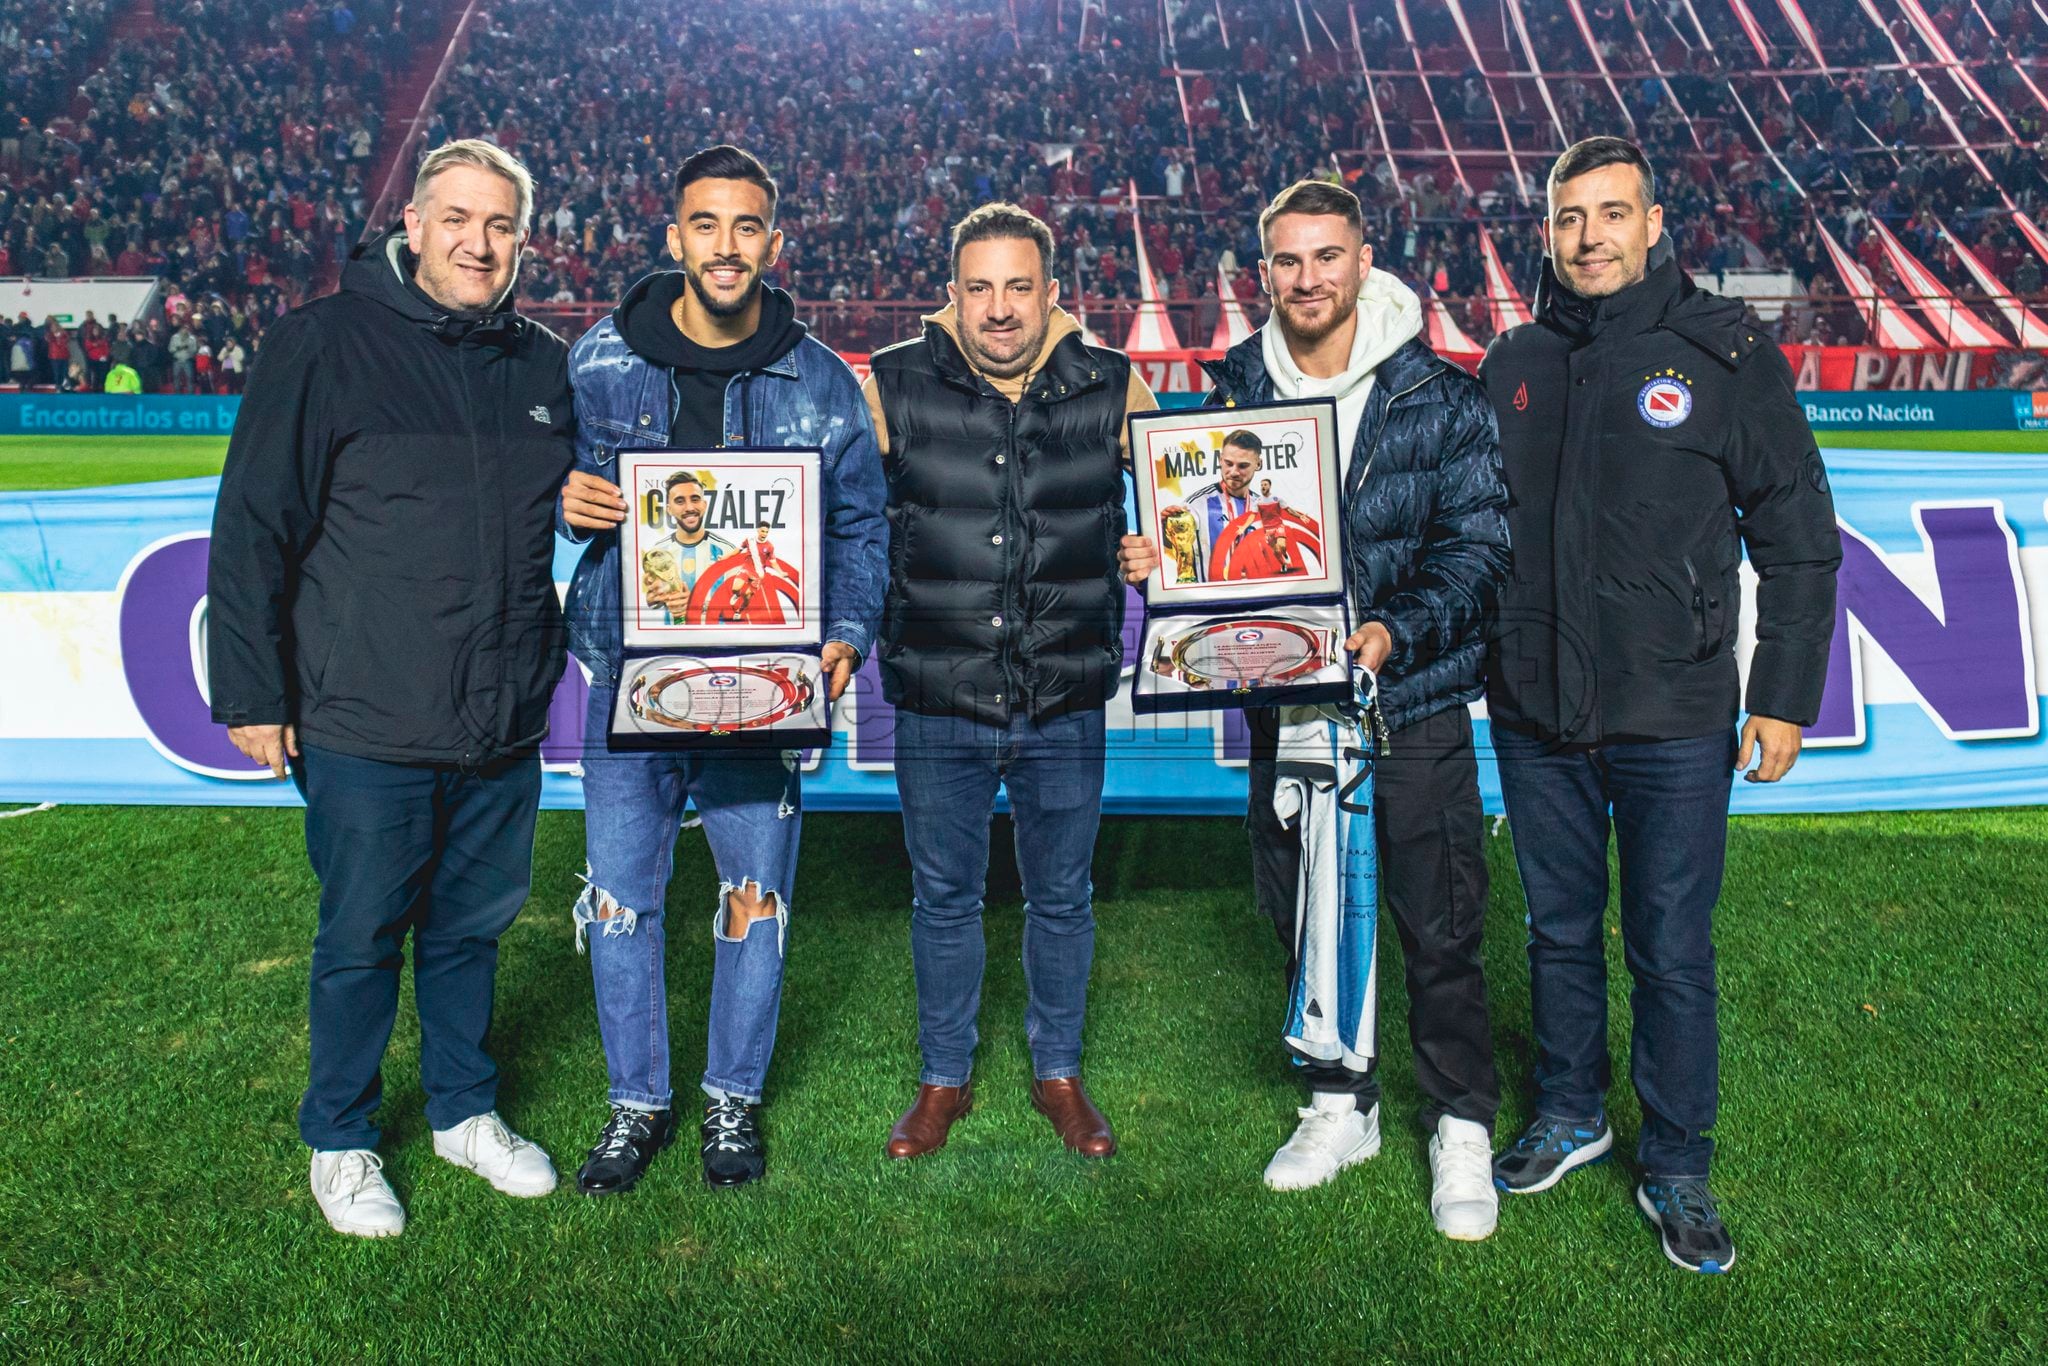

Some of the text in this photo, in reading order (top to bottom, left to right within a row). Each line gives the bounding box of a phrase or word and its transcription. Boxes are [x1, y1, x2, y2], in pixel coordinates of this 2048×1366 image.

[20, 403, 172, 429] Encontralos
[178, 411, 210, 429] en
[1804, 402, 1935, 422] Banco Nación
[1163, 443, 1298, 479] MAC ATER
[646, 483, 786, 530] GZÁLEZ
